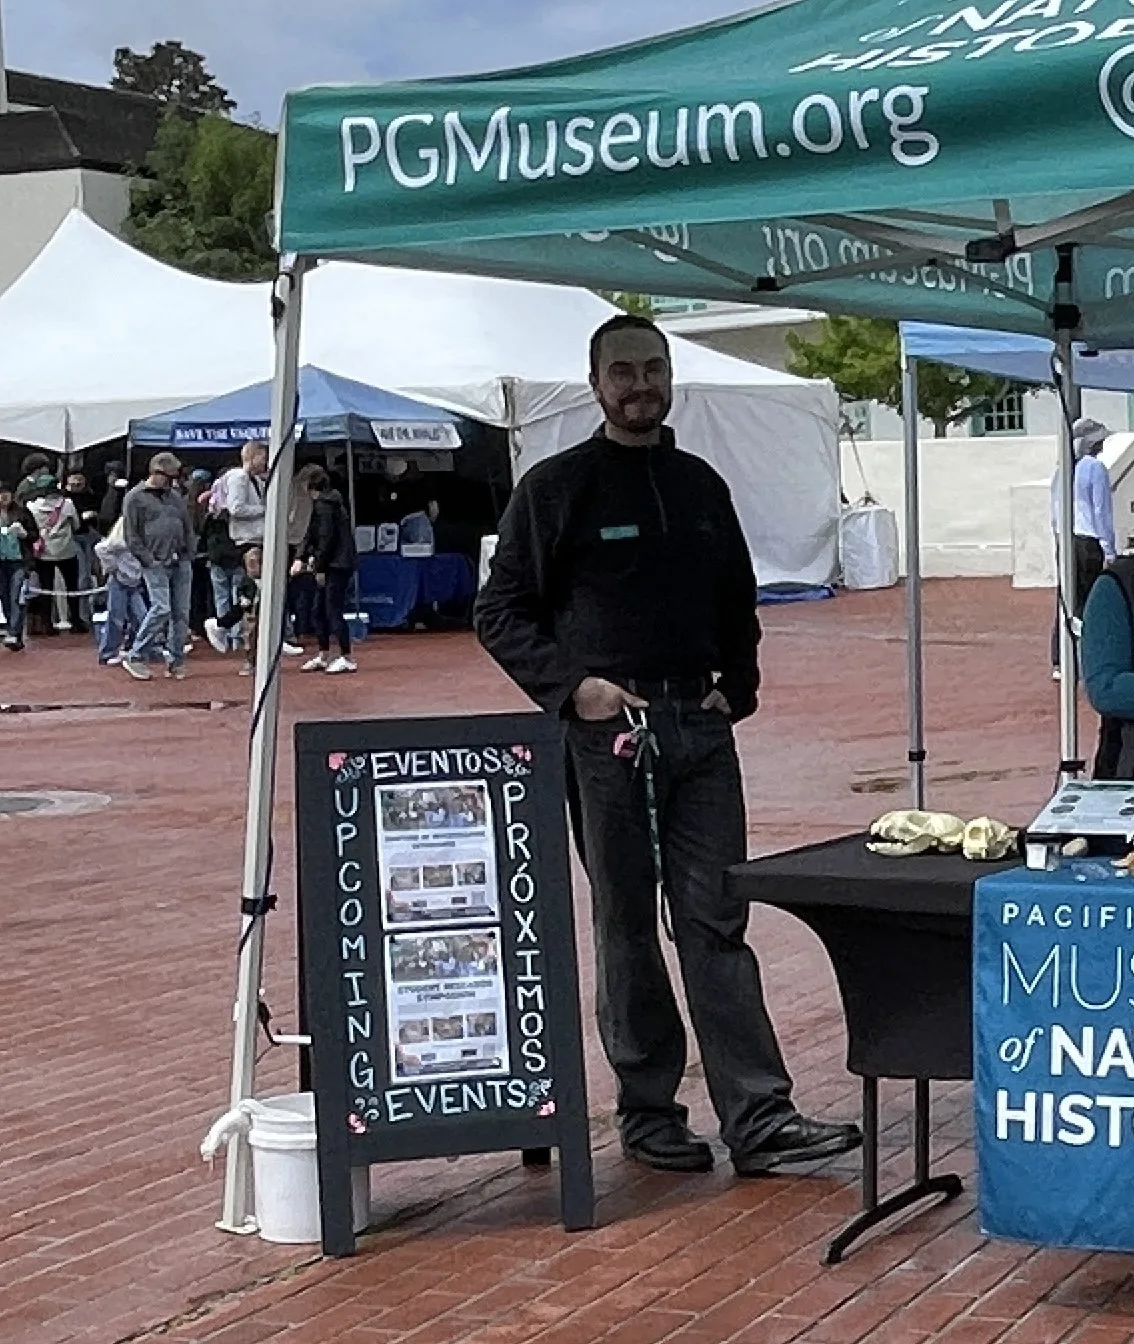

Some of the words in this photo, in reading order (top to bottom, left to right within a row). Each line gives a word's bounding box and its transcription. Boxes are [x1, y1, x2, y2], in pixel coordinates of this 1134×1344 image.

[341, 83, 941, 193] PGMuseum.org
[370, 747, 502, 780] EVENTOS
[334, 786, 375, 1092] UPCOMING
[998, 1027, 1044, 1074] of
[386, 1079, 526, 1122] EVENTS
